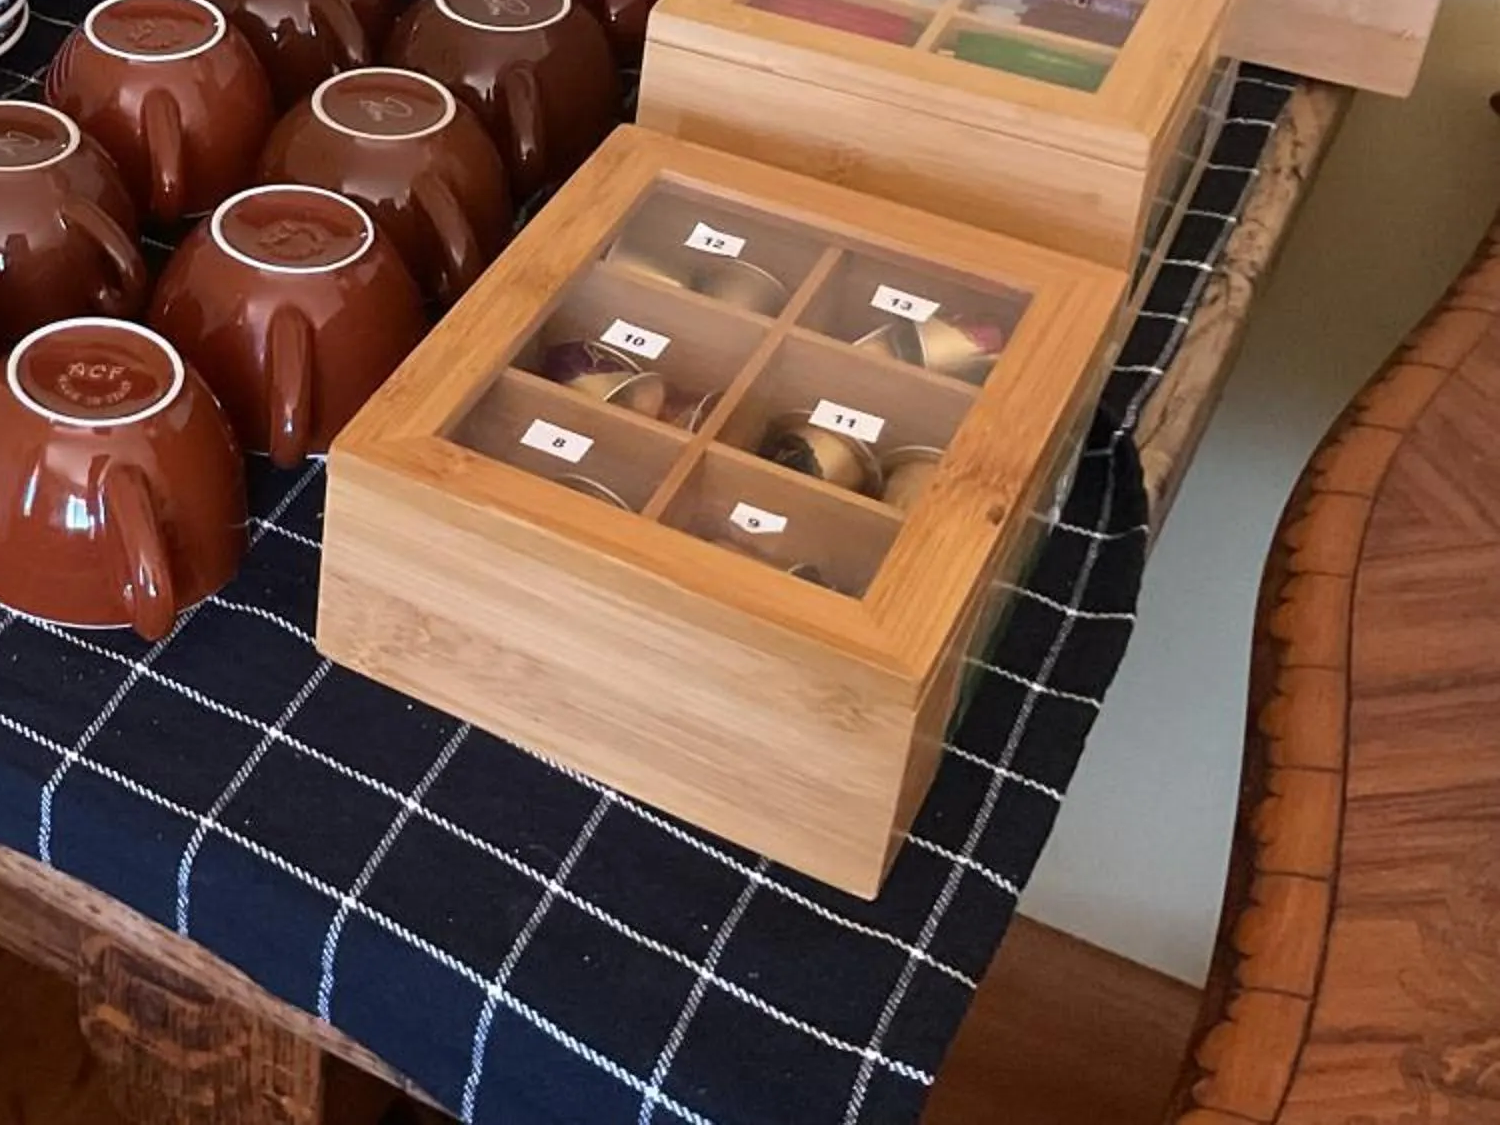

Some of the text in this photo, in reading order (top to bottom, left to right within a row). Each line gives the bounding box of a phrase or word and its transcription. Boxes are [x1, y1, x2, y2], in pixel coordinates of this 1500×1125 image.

[703, 236, 725, 249] 12
[890, 297, 913, 311] 13
[623, 333, 645, 347] 10
[834, 414, 857, 429] 11
[551, 437, 567, 449] 8
[746, 517, 762, 529] 9
